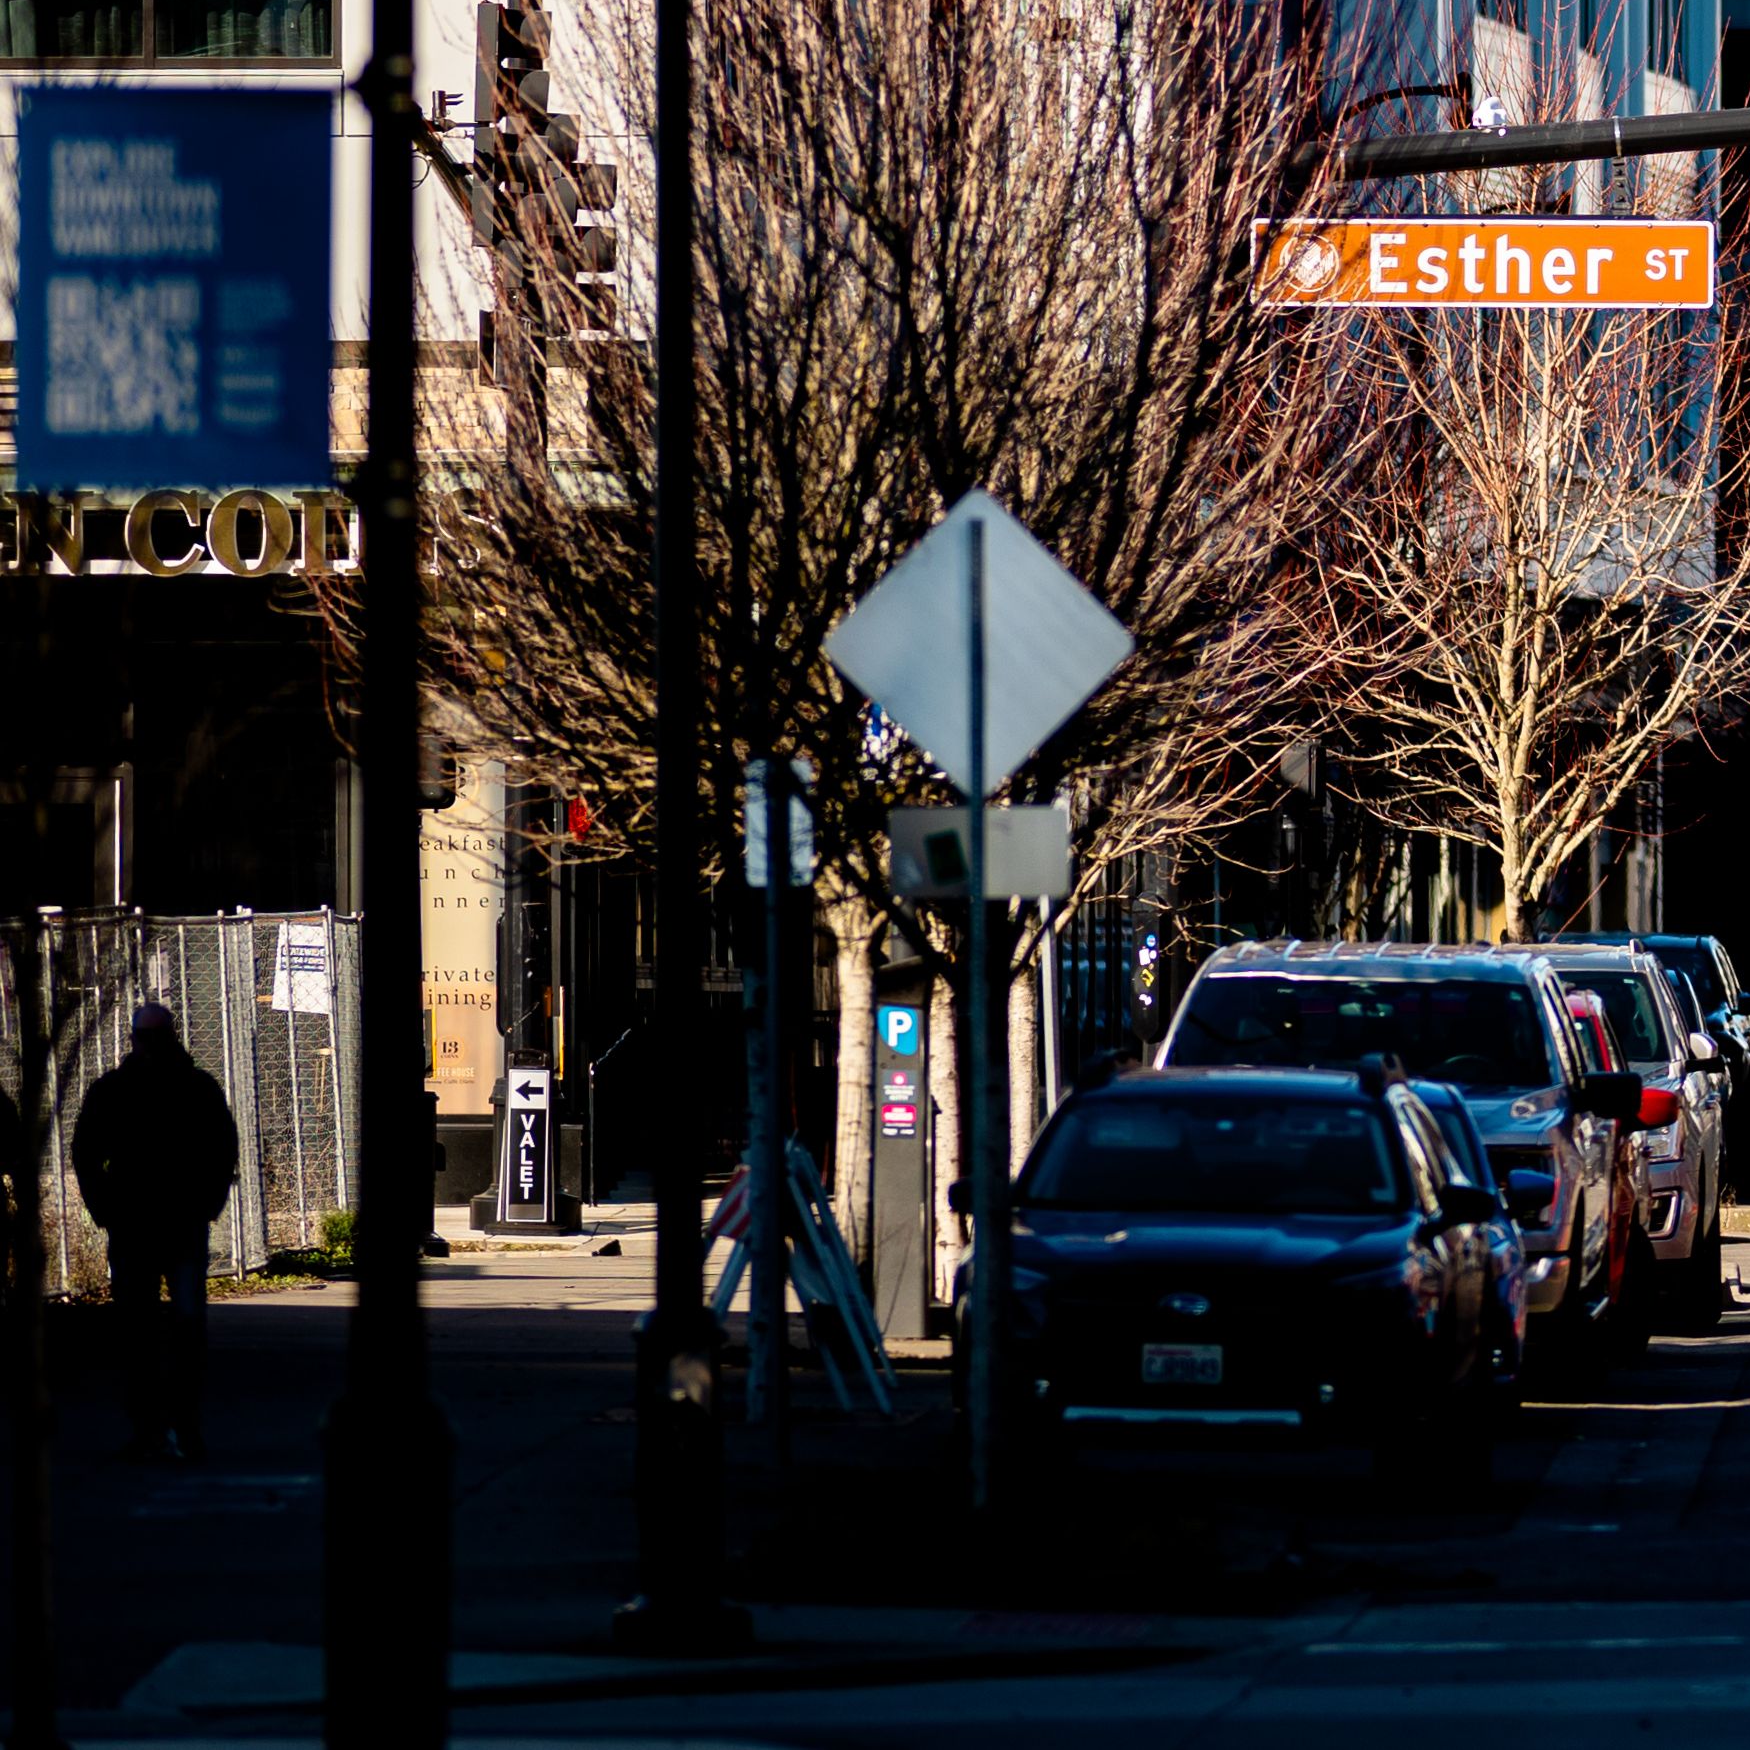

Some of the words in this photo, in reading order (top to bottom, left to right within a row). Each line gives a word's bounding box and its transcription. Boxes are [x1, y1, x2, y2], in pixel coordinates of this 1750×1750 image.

[1369, 232, 1613, 295] Esther
[1644, 248, 1690, 282] ST
[419, 834, 507, 851] eakfast
[420, 863, 507, 880] unch
[433, 896, 506, 909] nner
[422, 965, 495, 983] rivate
[428, 988, 492, 1012] ining
[887, 1010, 913, 1047] P
[519, 1113, 536, 1200] VALET
